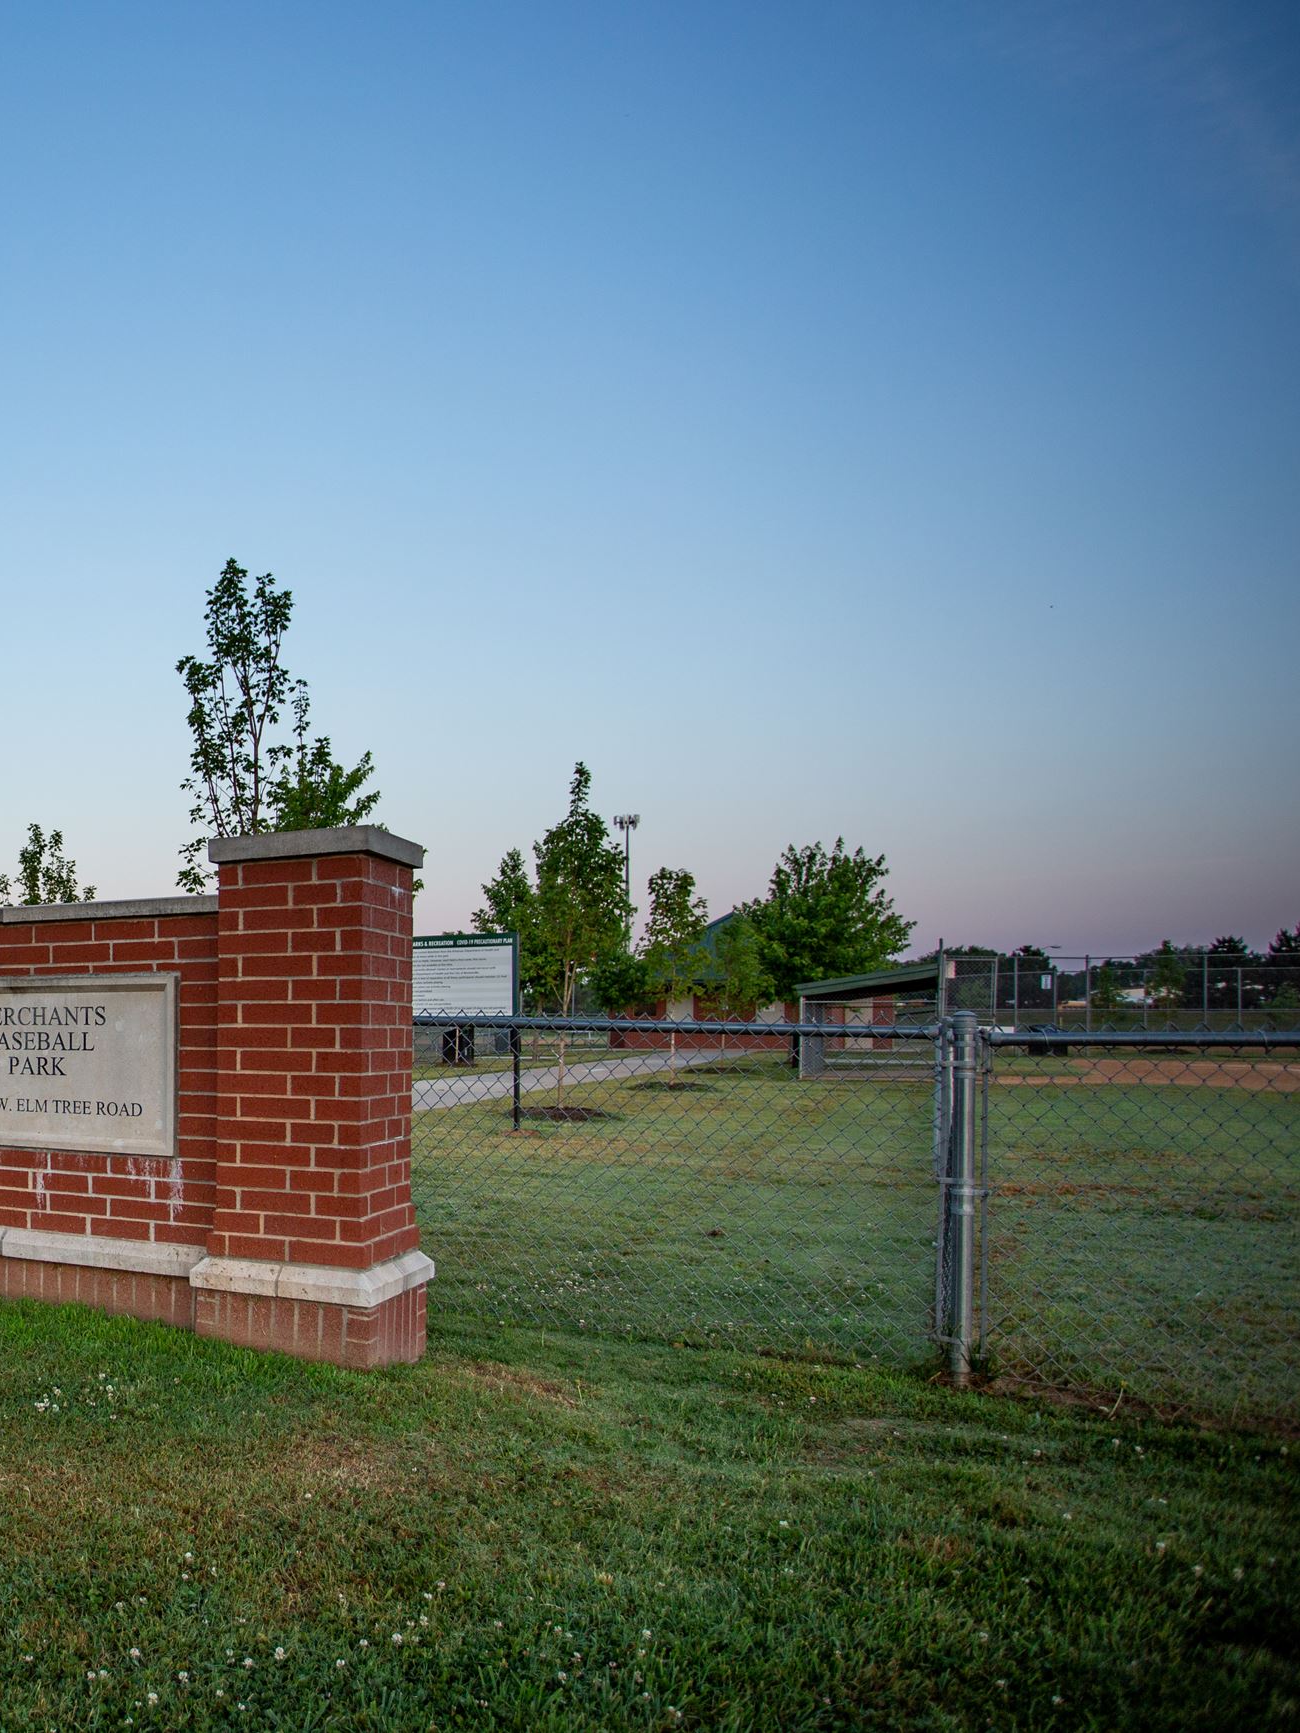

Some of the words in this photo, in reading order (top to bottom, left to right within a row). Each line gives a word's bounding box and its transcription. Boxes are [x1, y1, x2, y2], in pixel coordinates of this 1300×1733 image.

[8, 1056, 67, 1076] PARK
[16, 1098, 48, 1113] ELM
[52, 1099, 92, 1115] TREE
[96, 1101, 143, 1117] ROAD
